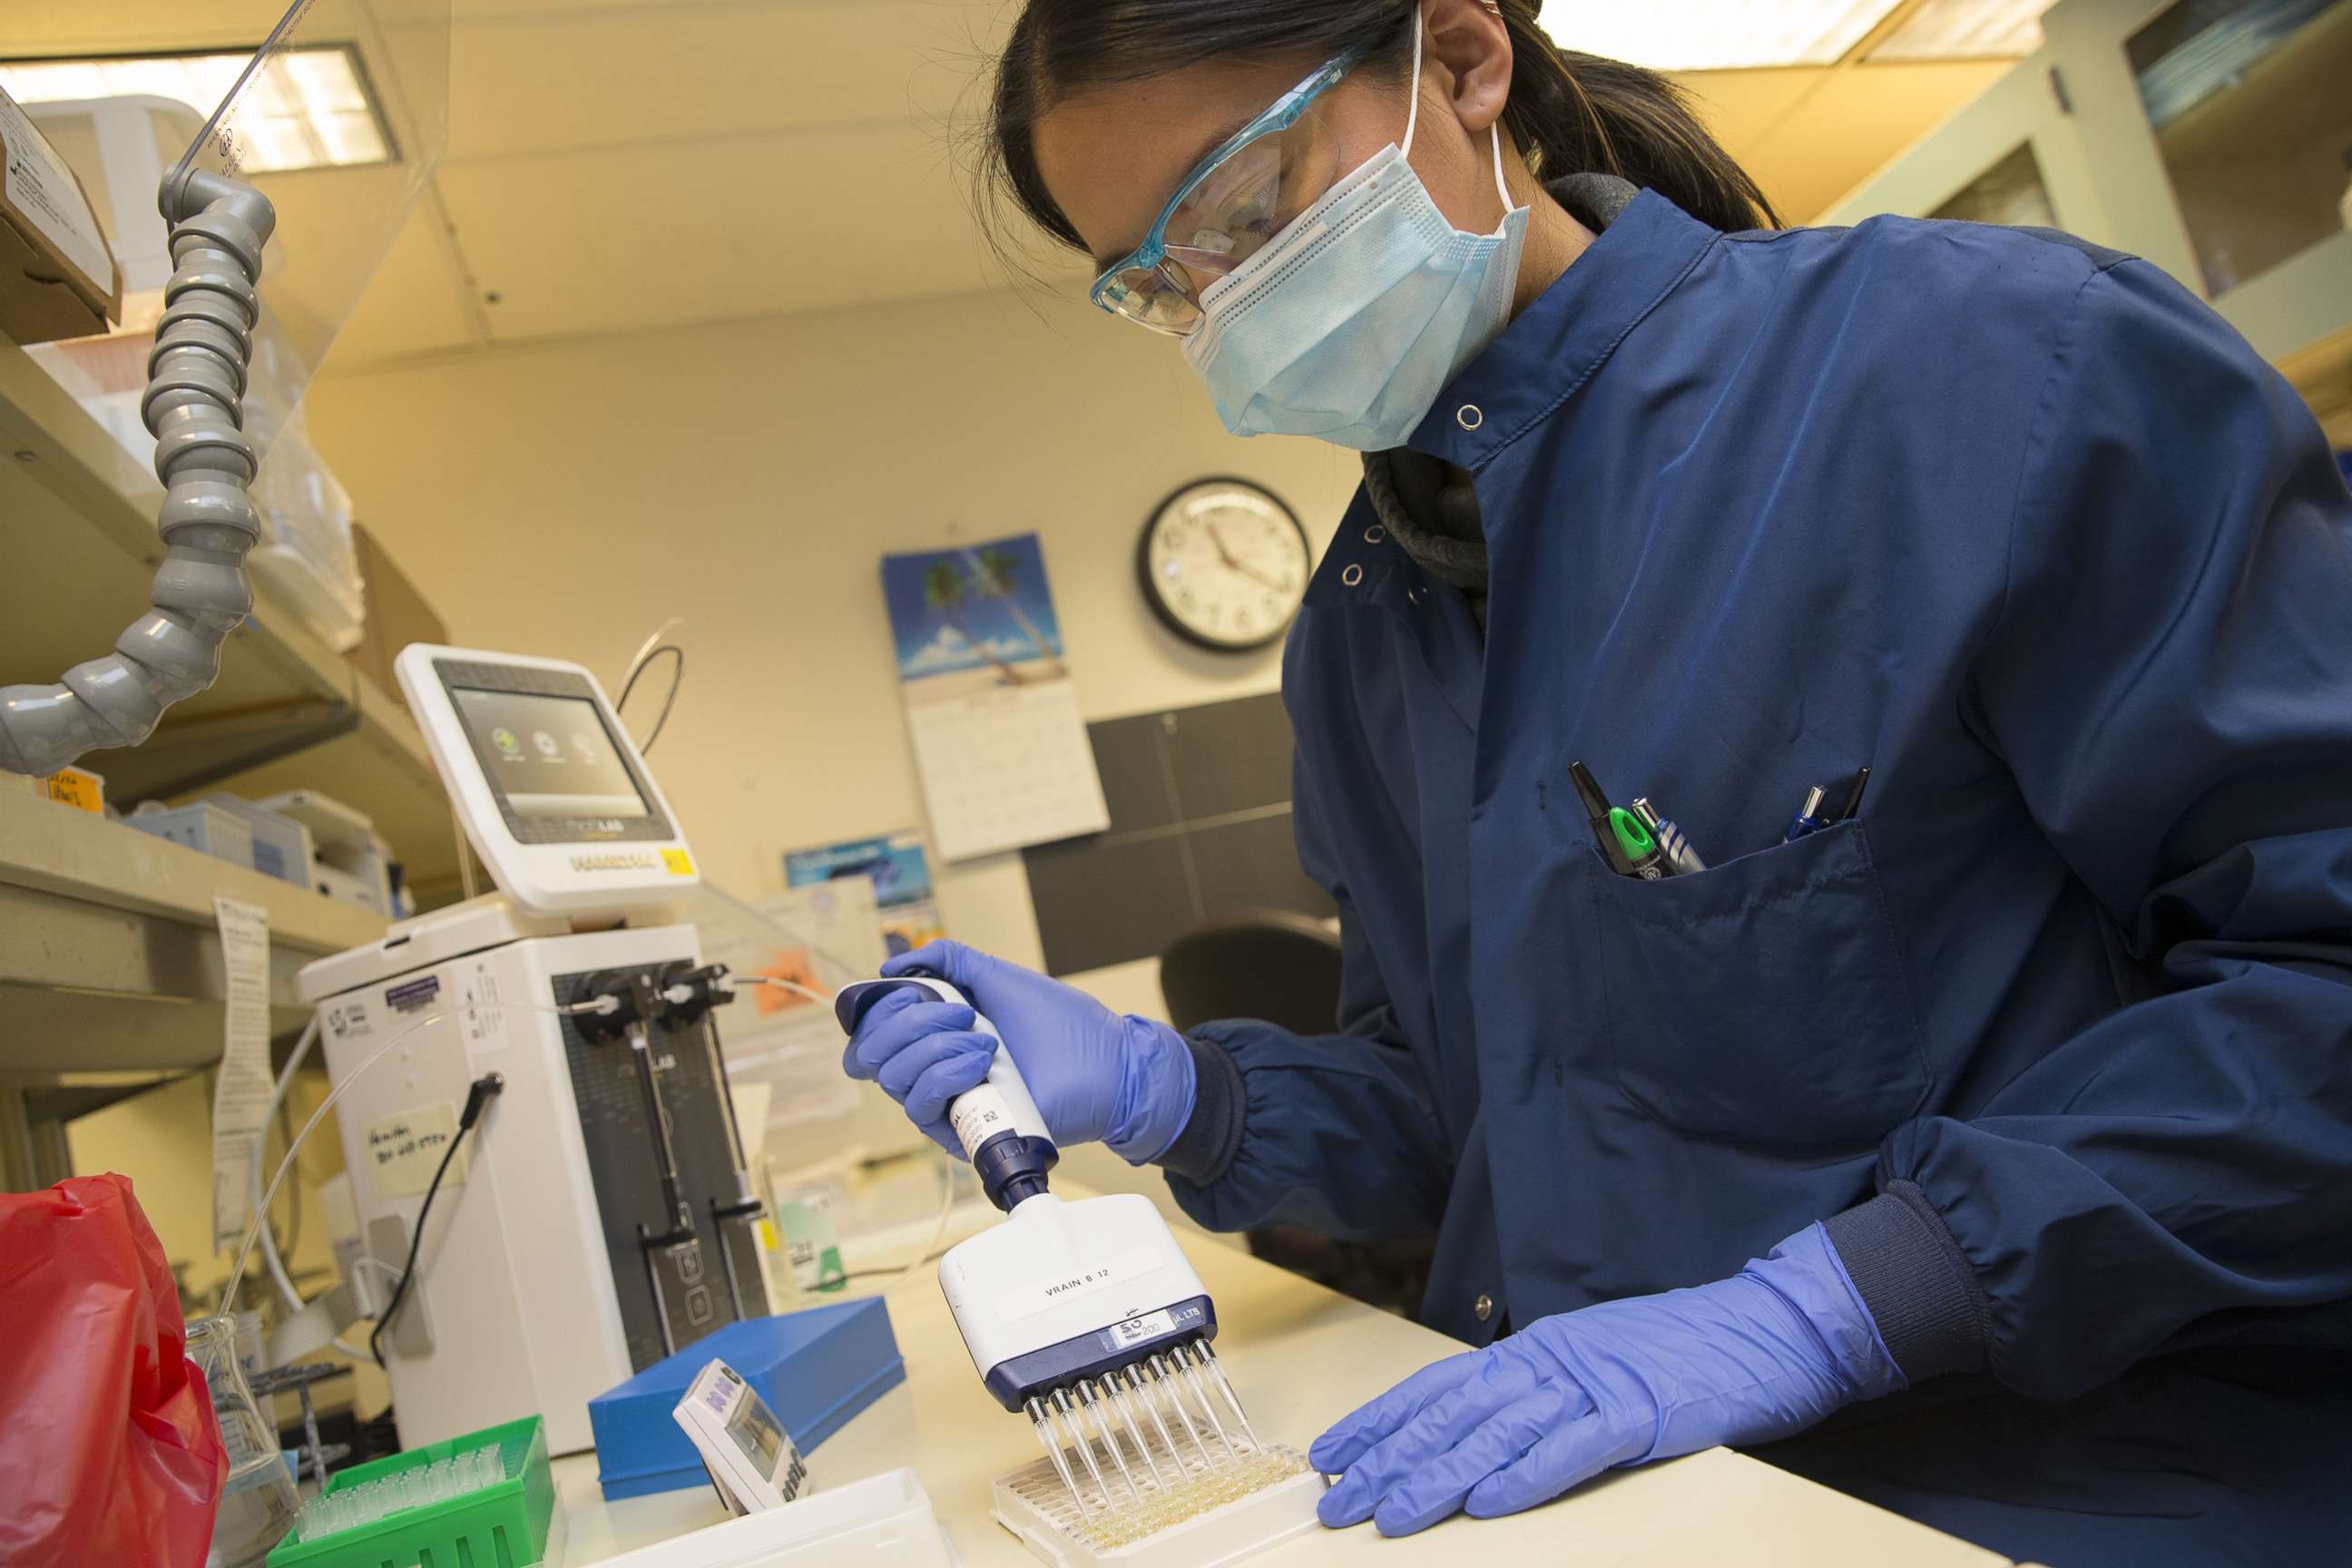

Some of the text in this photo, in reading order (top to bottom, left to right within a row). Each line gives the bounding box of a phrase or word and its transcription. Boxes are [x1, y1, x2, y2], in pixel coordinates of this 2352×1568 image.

[1045, 1279, 1082, 1297] VRAIN
[1098, 1269, 1110, 1279] 12
[1184, 1307, 1200, 1319] LTS
